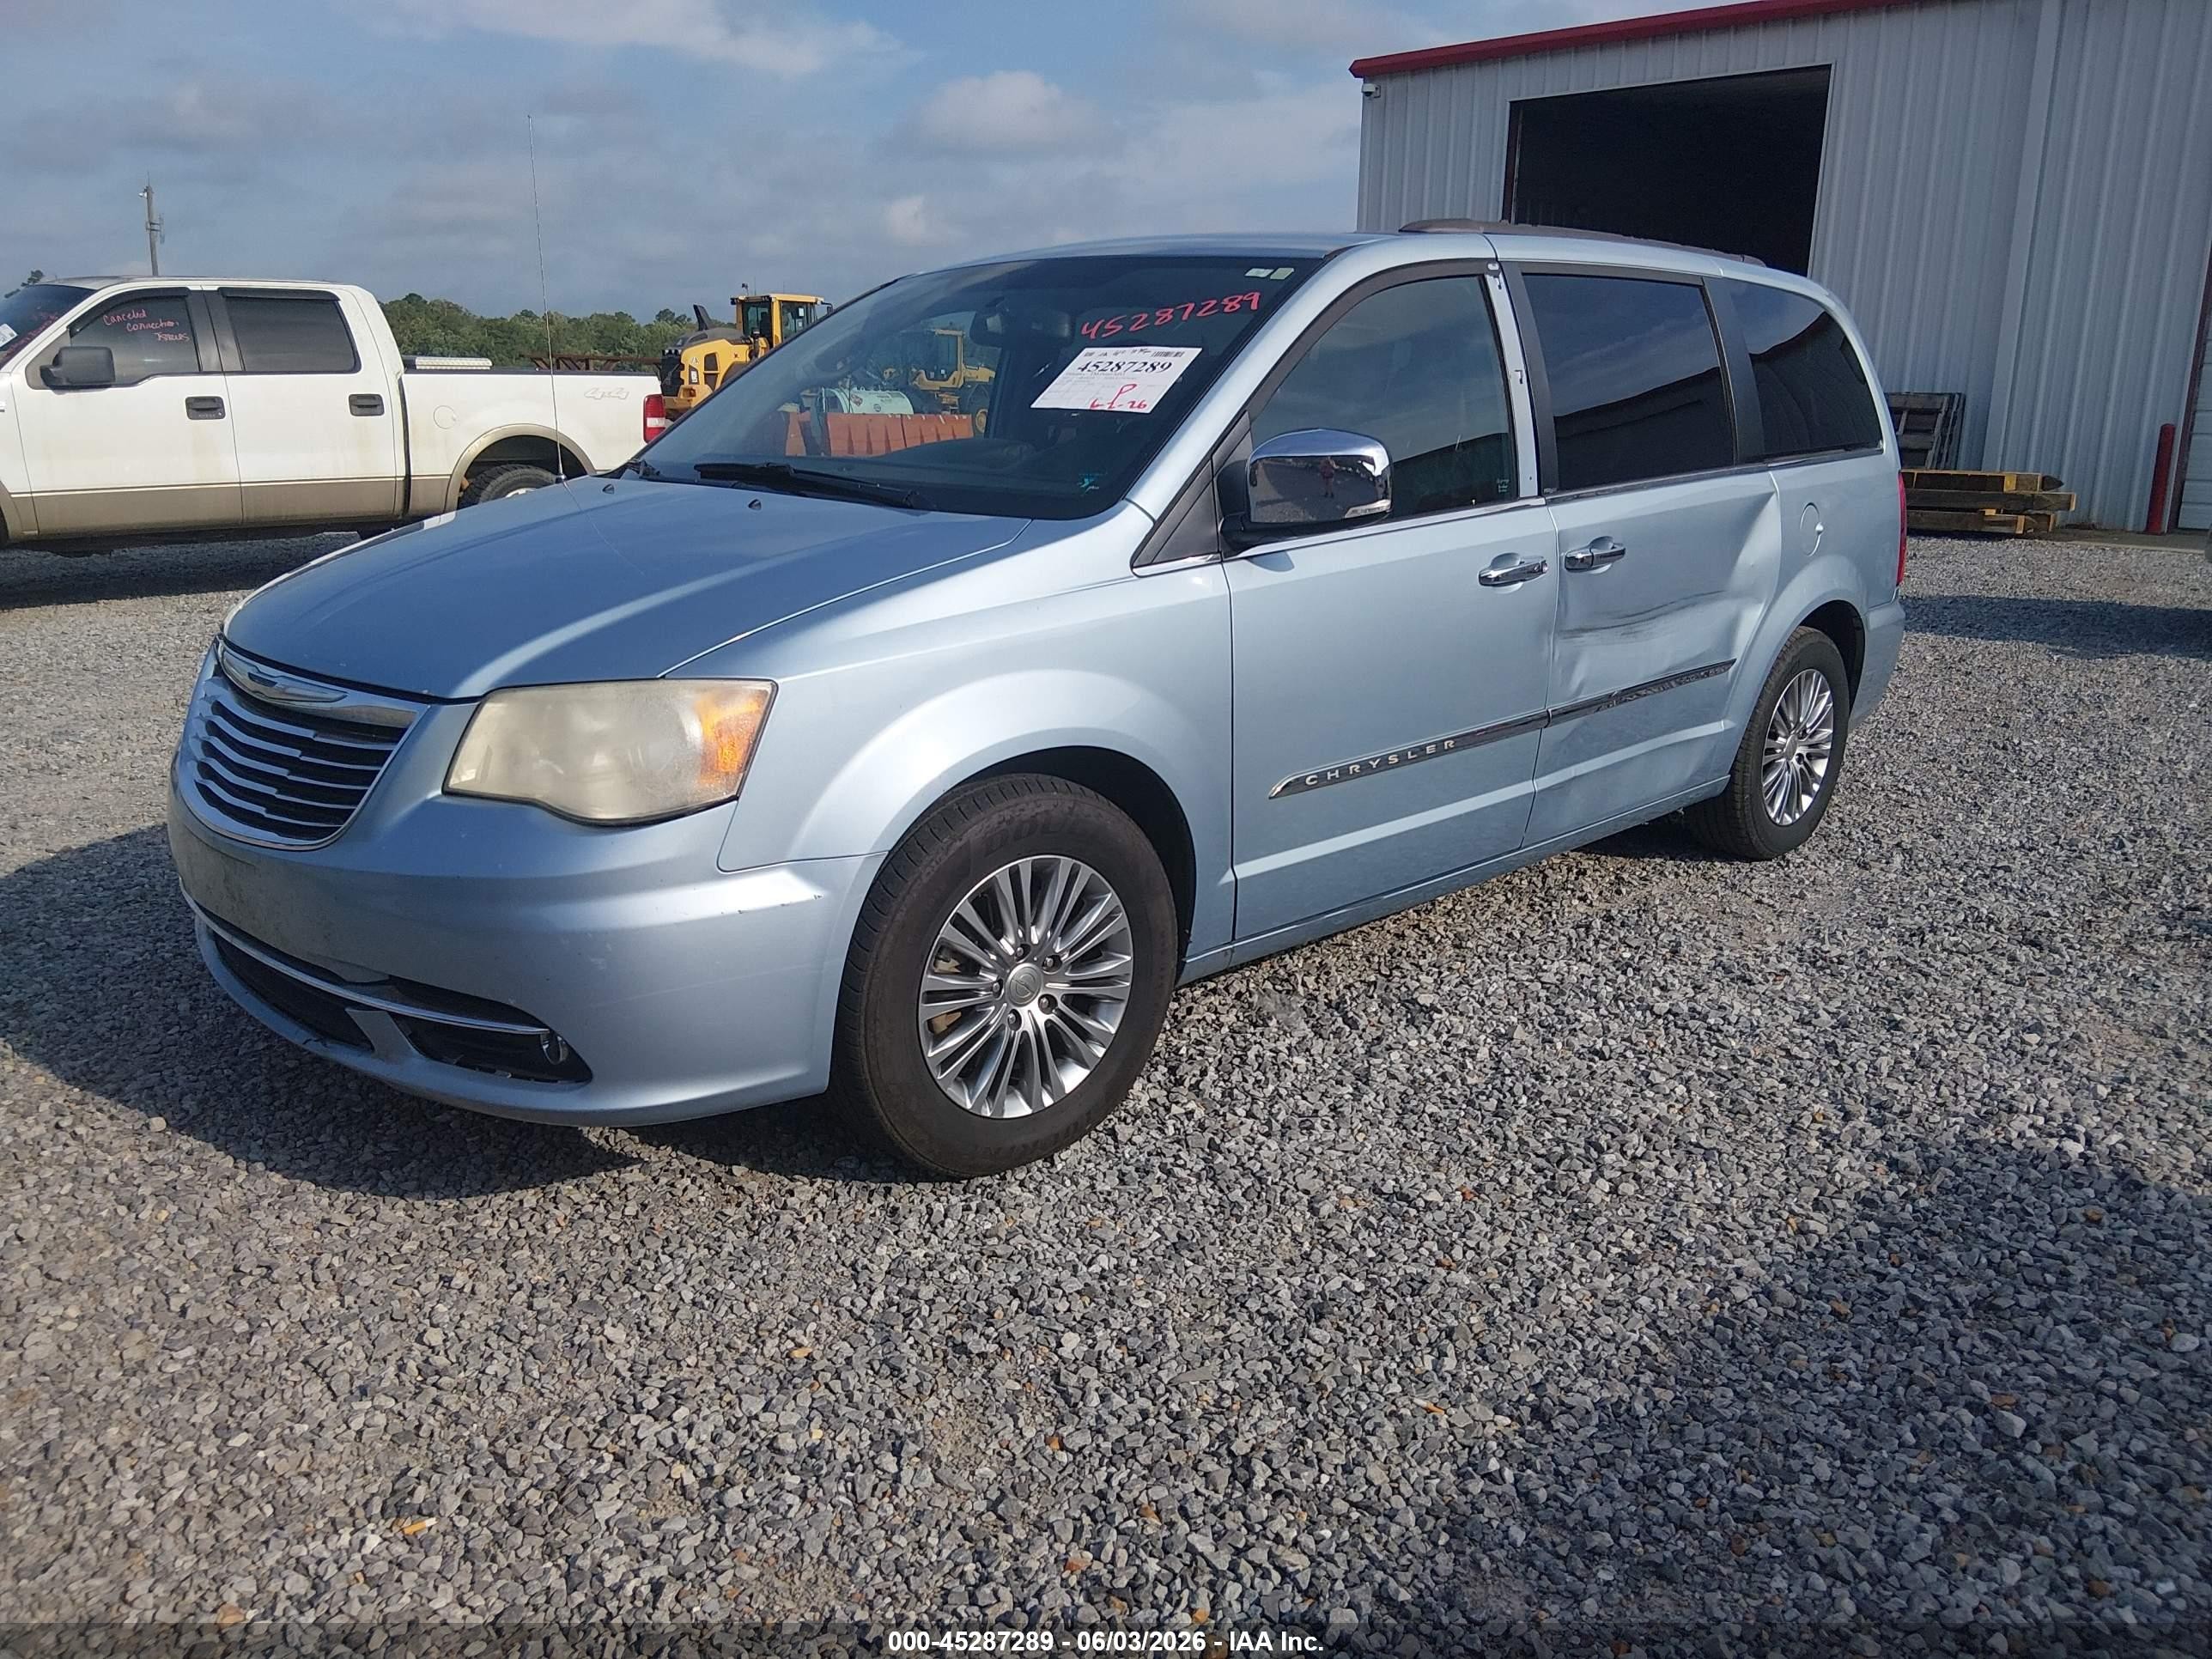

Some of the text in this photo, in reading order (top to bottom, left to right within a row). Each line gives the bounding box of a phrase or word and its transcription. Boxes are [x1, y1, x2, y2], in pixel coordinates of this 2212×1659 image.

[1081, 291, 1261, 340] 45287289
[1078, 361, 1172, 373] 45287289
[1305, 739, 1455, 786] CHRYSLER
